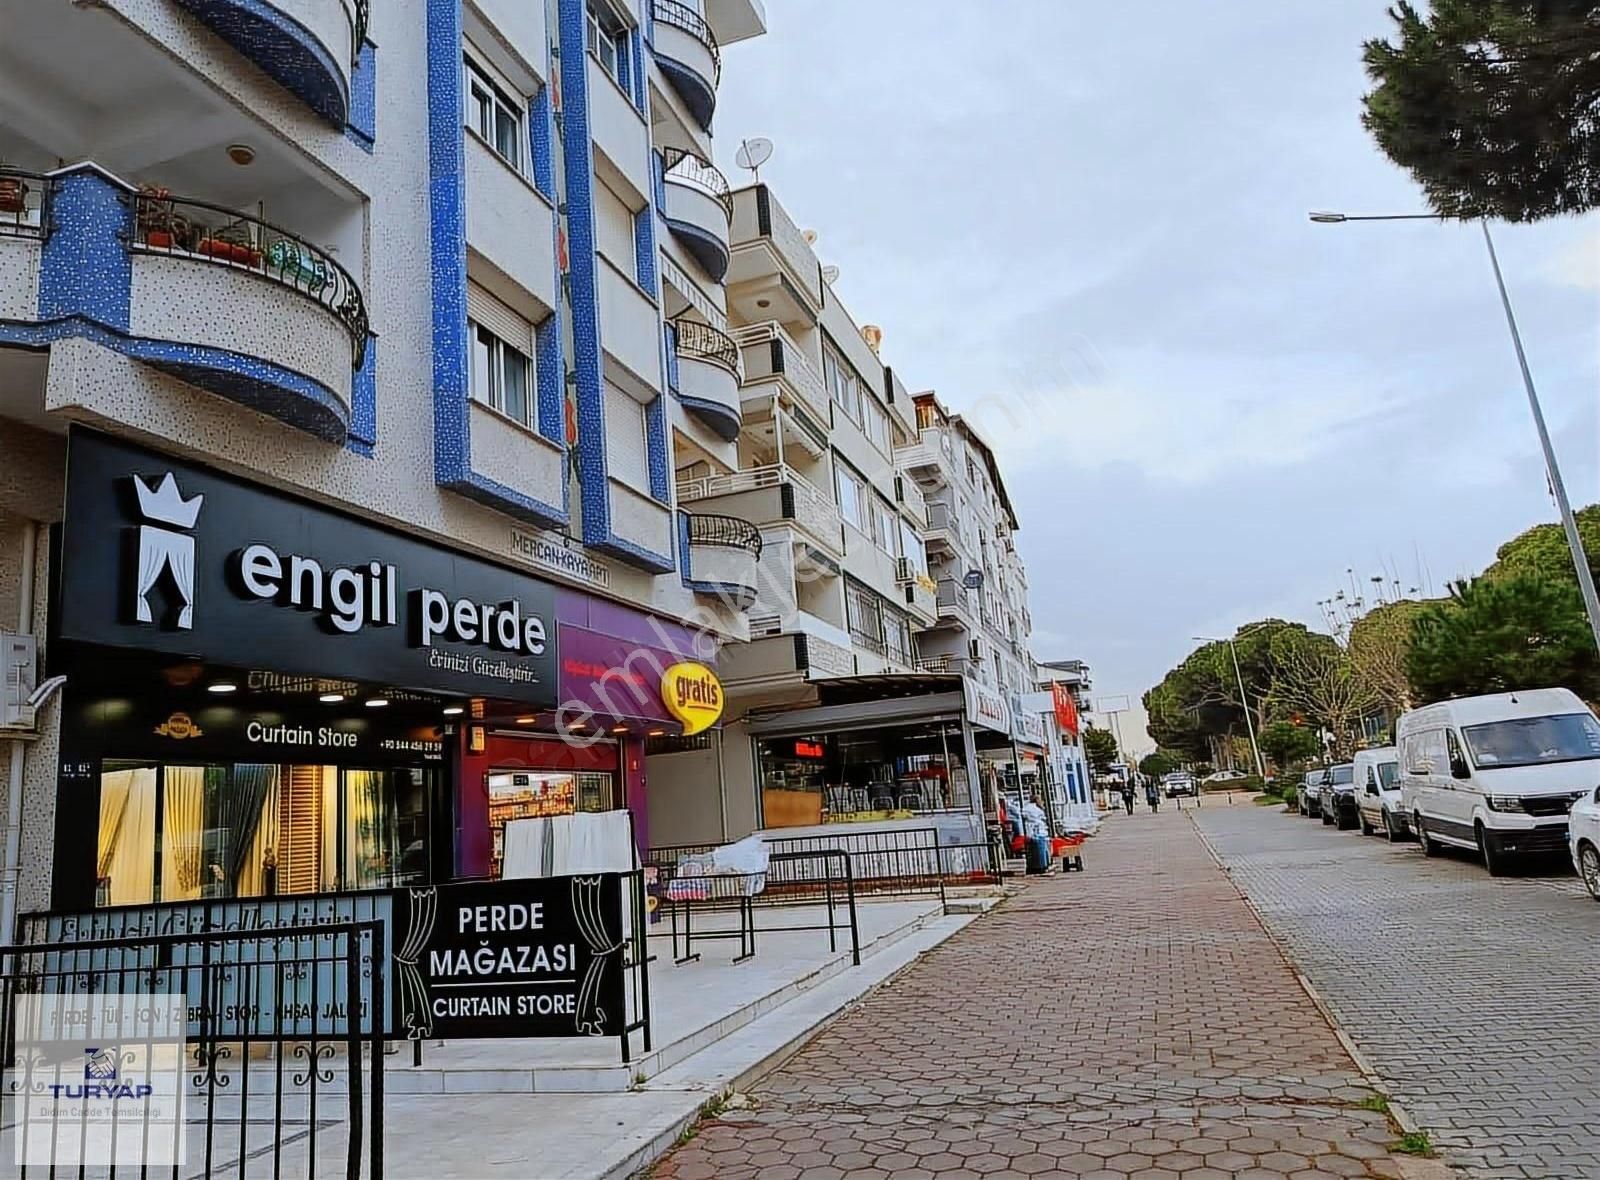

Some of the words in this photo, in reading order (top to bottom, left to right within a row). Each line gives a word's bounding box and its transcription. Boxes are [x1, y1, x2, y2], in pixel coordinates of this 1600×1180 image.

[240, 541, 397, 633] engil
[421, 587, 547, 656] perde
[676, 672, 718, 708] gratis
[247, 721, 313, 745] Curtain
[318, 727, 358, 747] Store
[458, 902, 545, 934] PERDE
[430, 940, 577, 977] MAĞAZASI
[432, 995, 511, 1018] CURTAIN
[517, 993, 576, 1016] STORE
